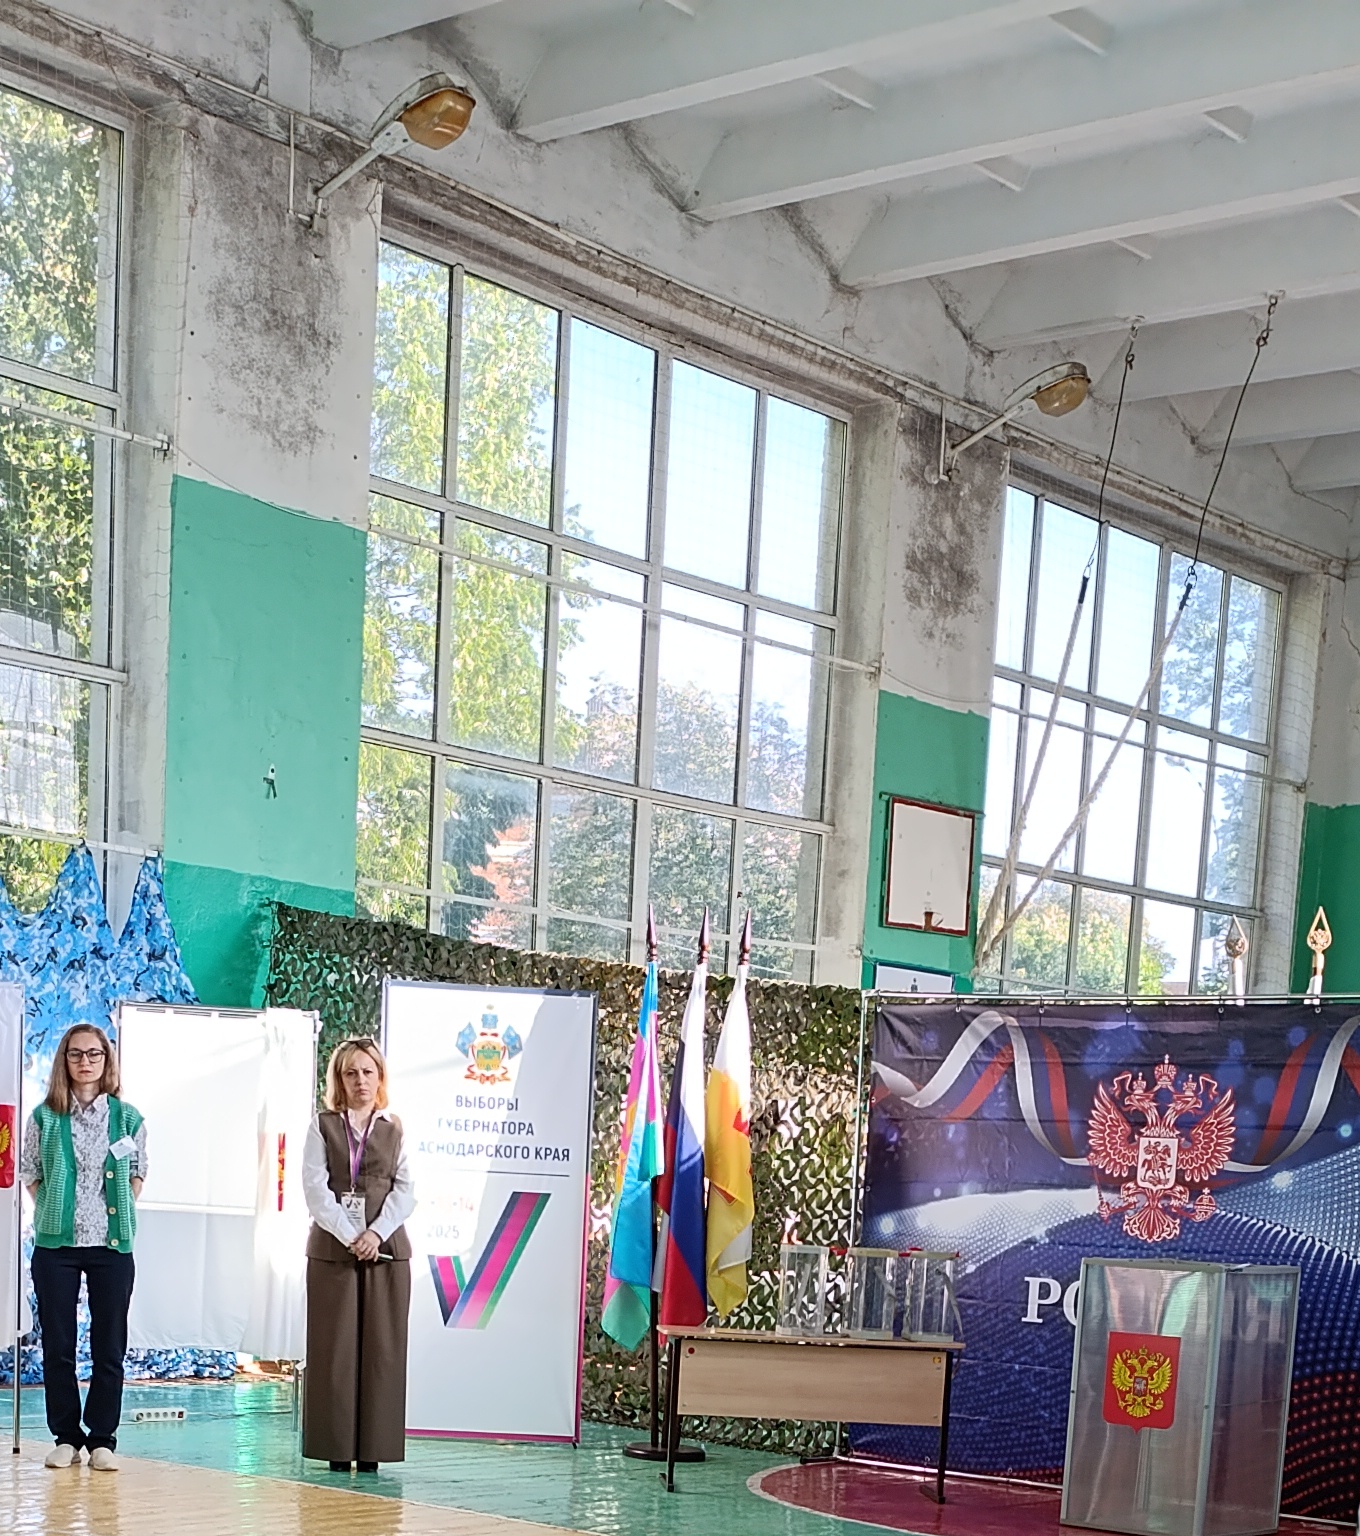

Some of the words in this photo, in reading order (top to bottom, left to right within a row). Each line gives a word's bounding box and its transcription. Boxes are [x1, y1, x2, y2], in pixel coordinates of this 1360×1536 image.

[455, 1095, 519, 1112] ВЫБОРЫ
[438, 1118, 535, 1136] ГУБЕРНАТОРА
[535, 1147, 570, 1162] КРАЯ
